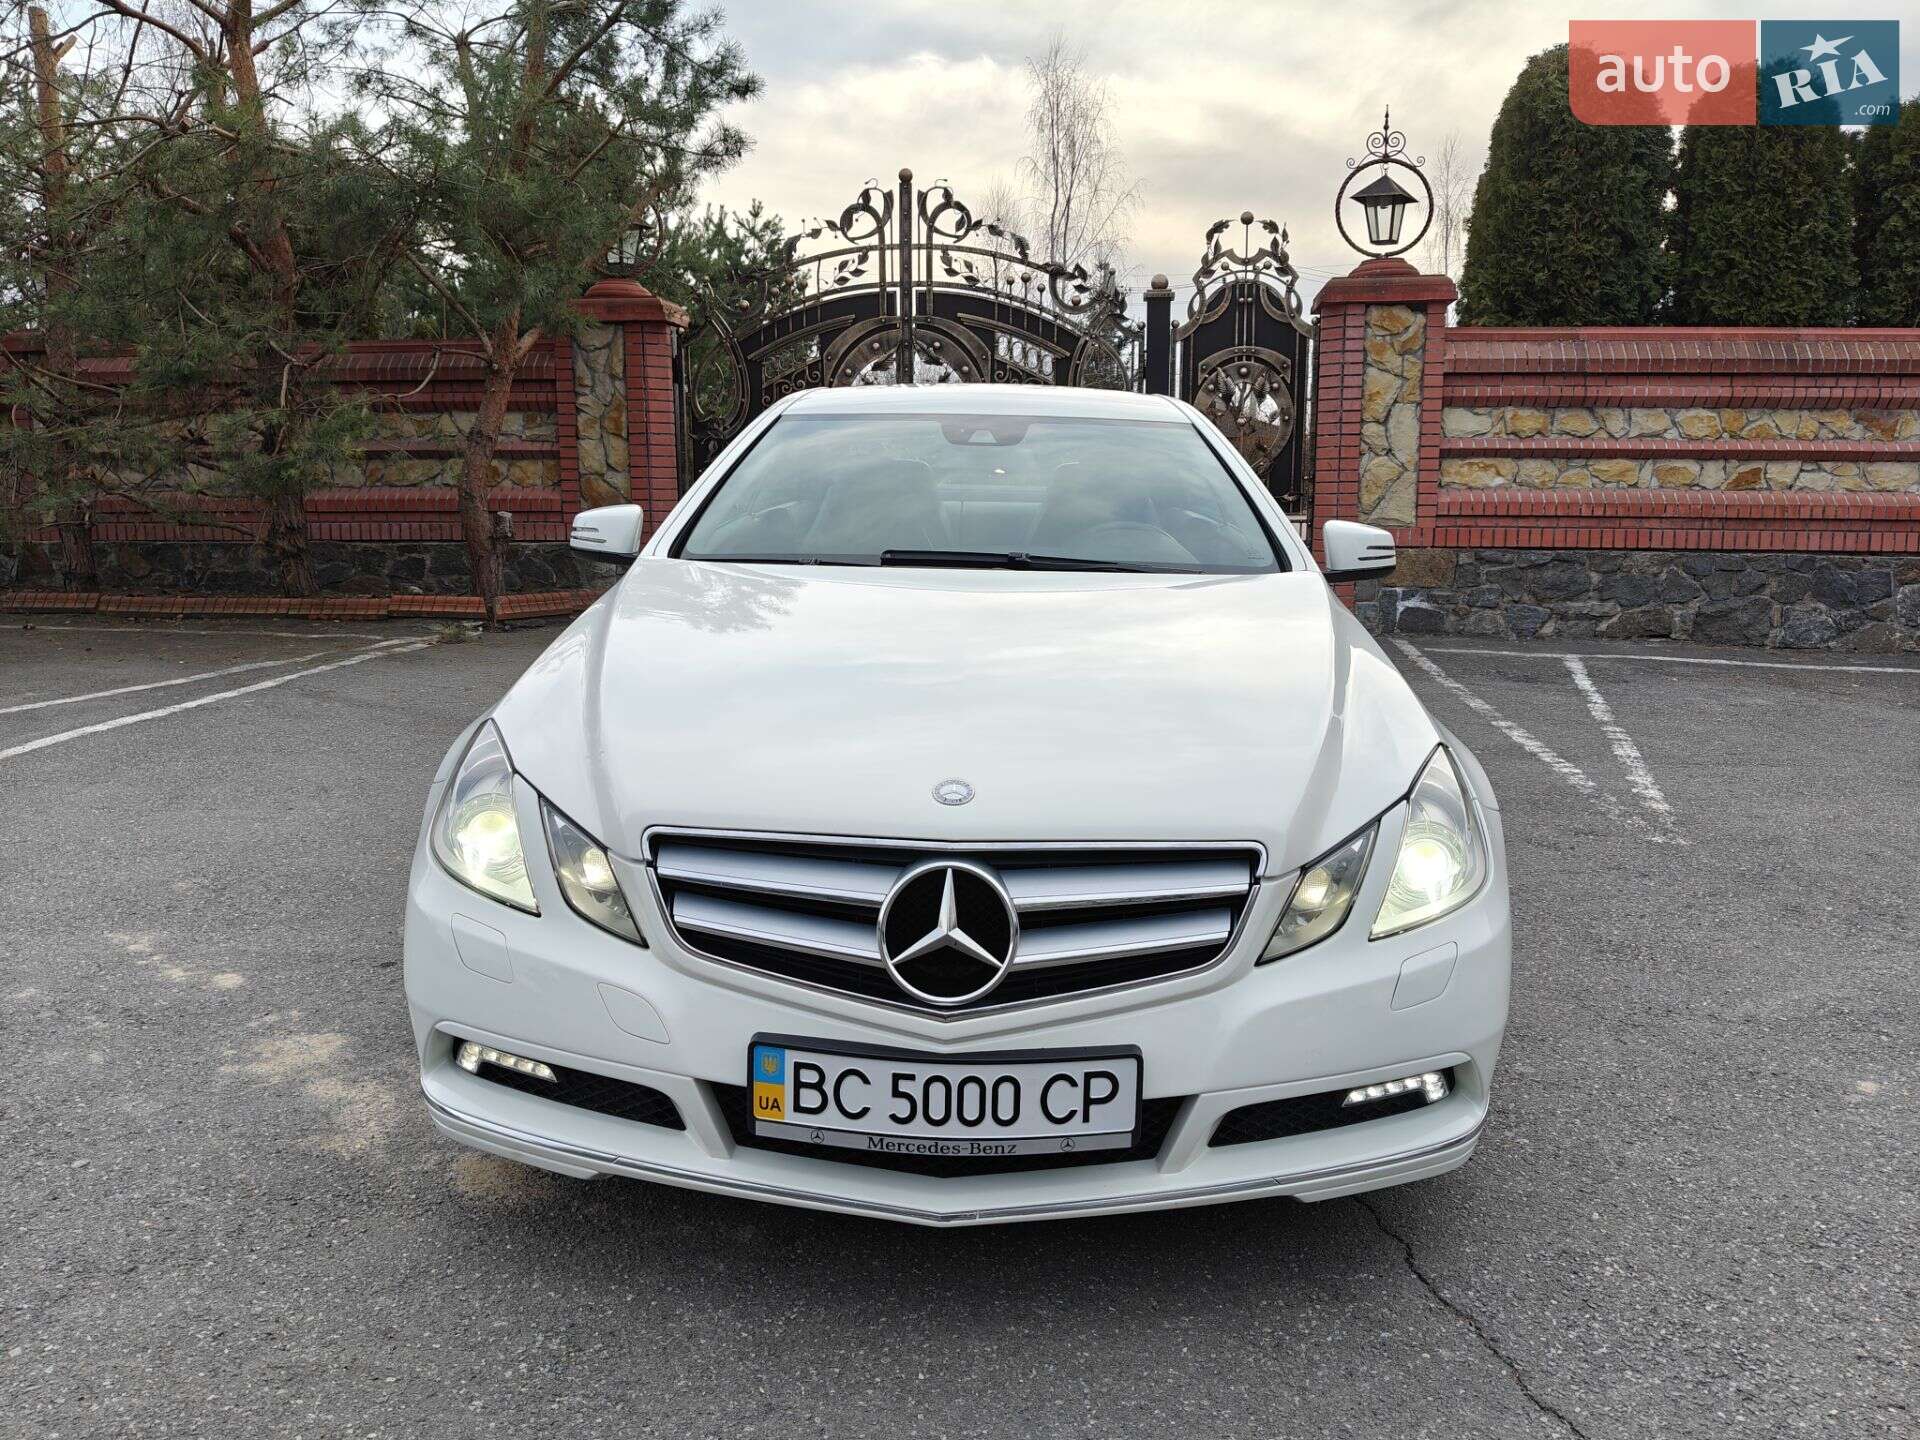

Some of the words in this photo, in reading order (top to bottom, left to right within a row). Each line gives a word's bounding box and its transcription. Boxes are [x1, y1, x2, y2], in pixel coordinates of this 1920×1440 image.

[792, 1060, 871, 1120] BC
[888, 1072, 1021, 1127] 5000
[1039, 1070, 1120, 1124] CP
[758, 1096, 782, 1113] UA
[868, 1136, 1017, 1155] Mercedes-Benz
